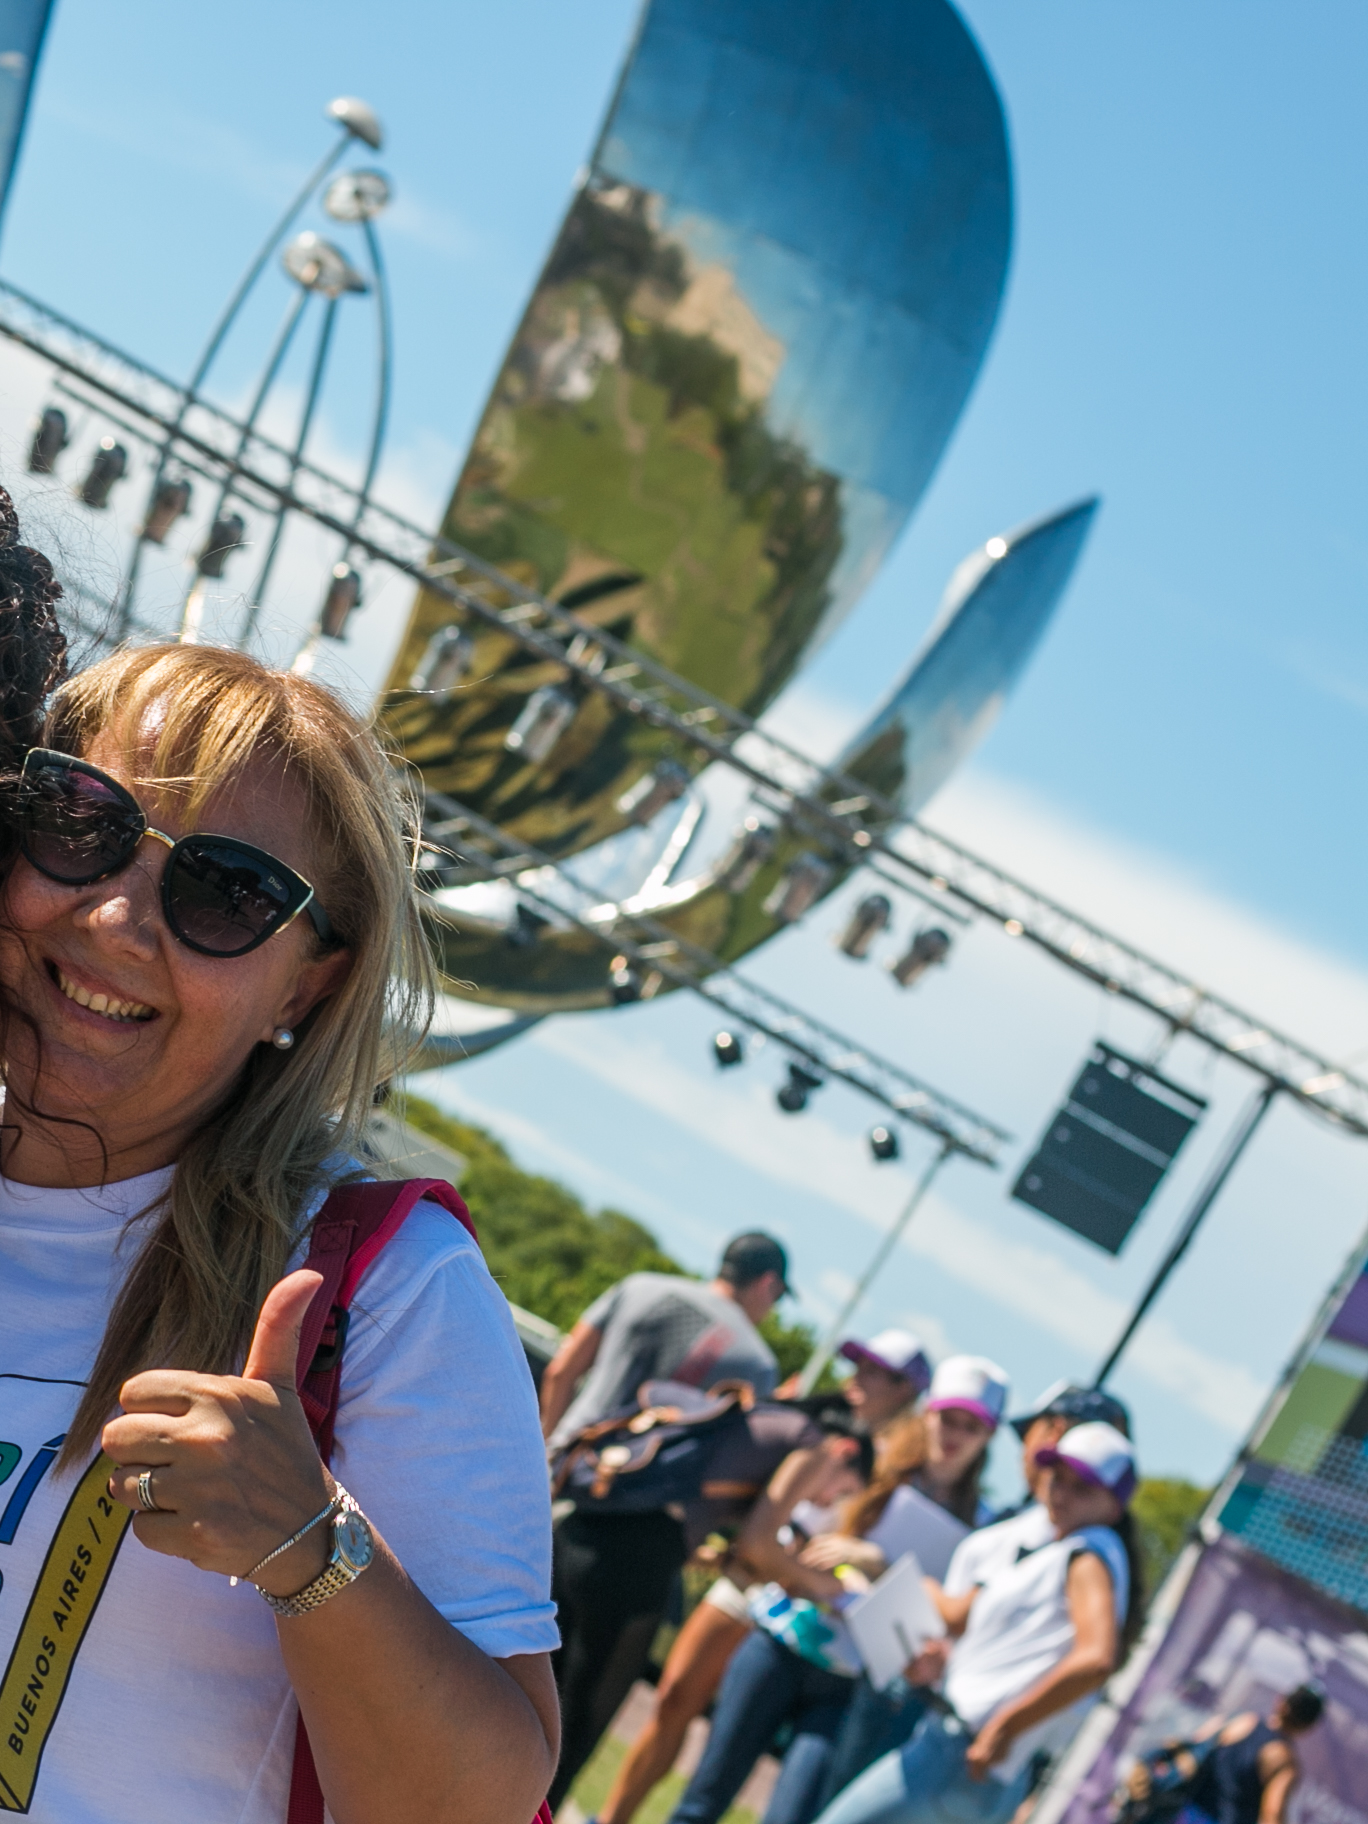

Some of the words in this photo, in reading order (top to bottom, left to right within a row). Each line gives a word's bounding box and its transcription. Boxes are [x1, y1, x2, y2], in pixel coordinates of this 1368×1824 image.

[267, 875, 283, 891] Dior
[7, 1636, 57, 1756] BUENOS
[52, 1544, 93, 1632] AIRES
